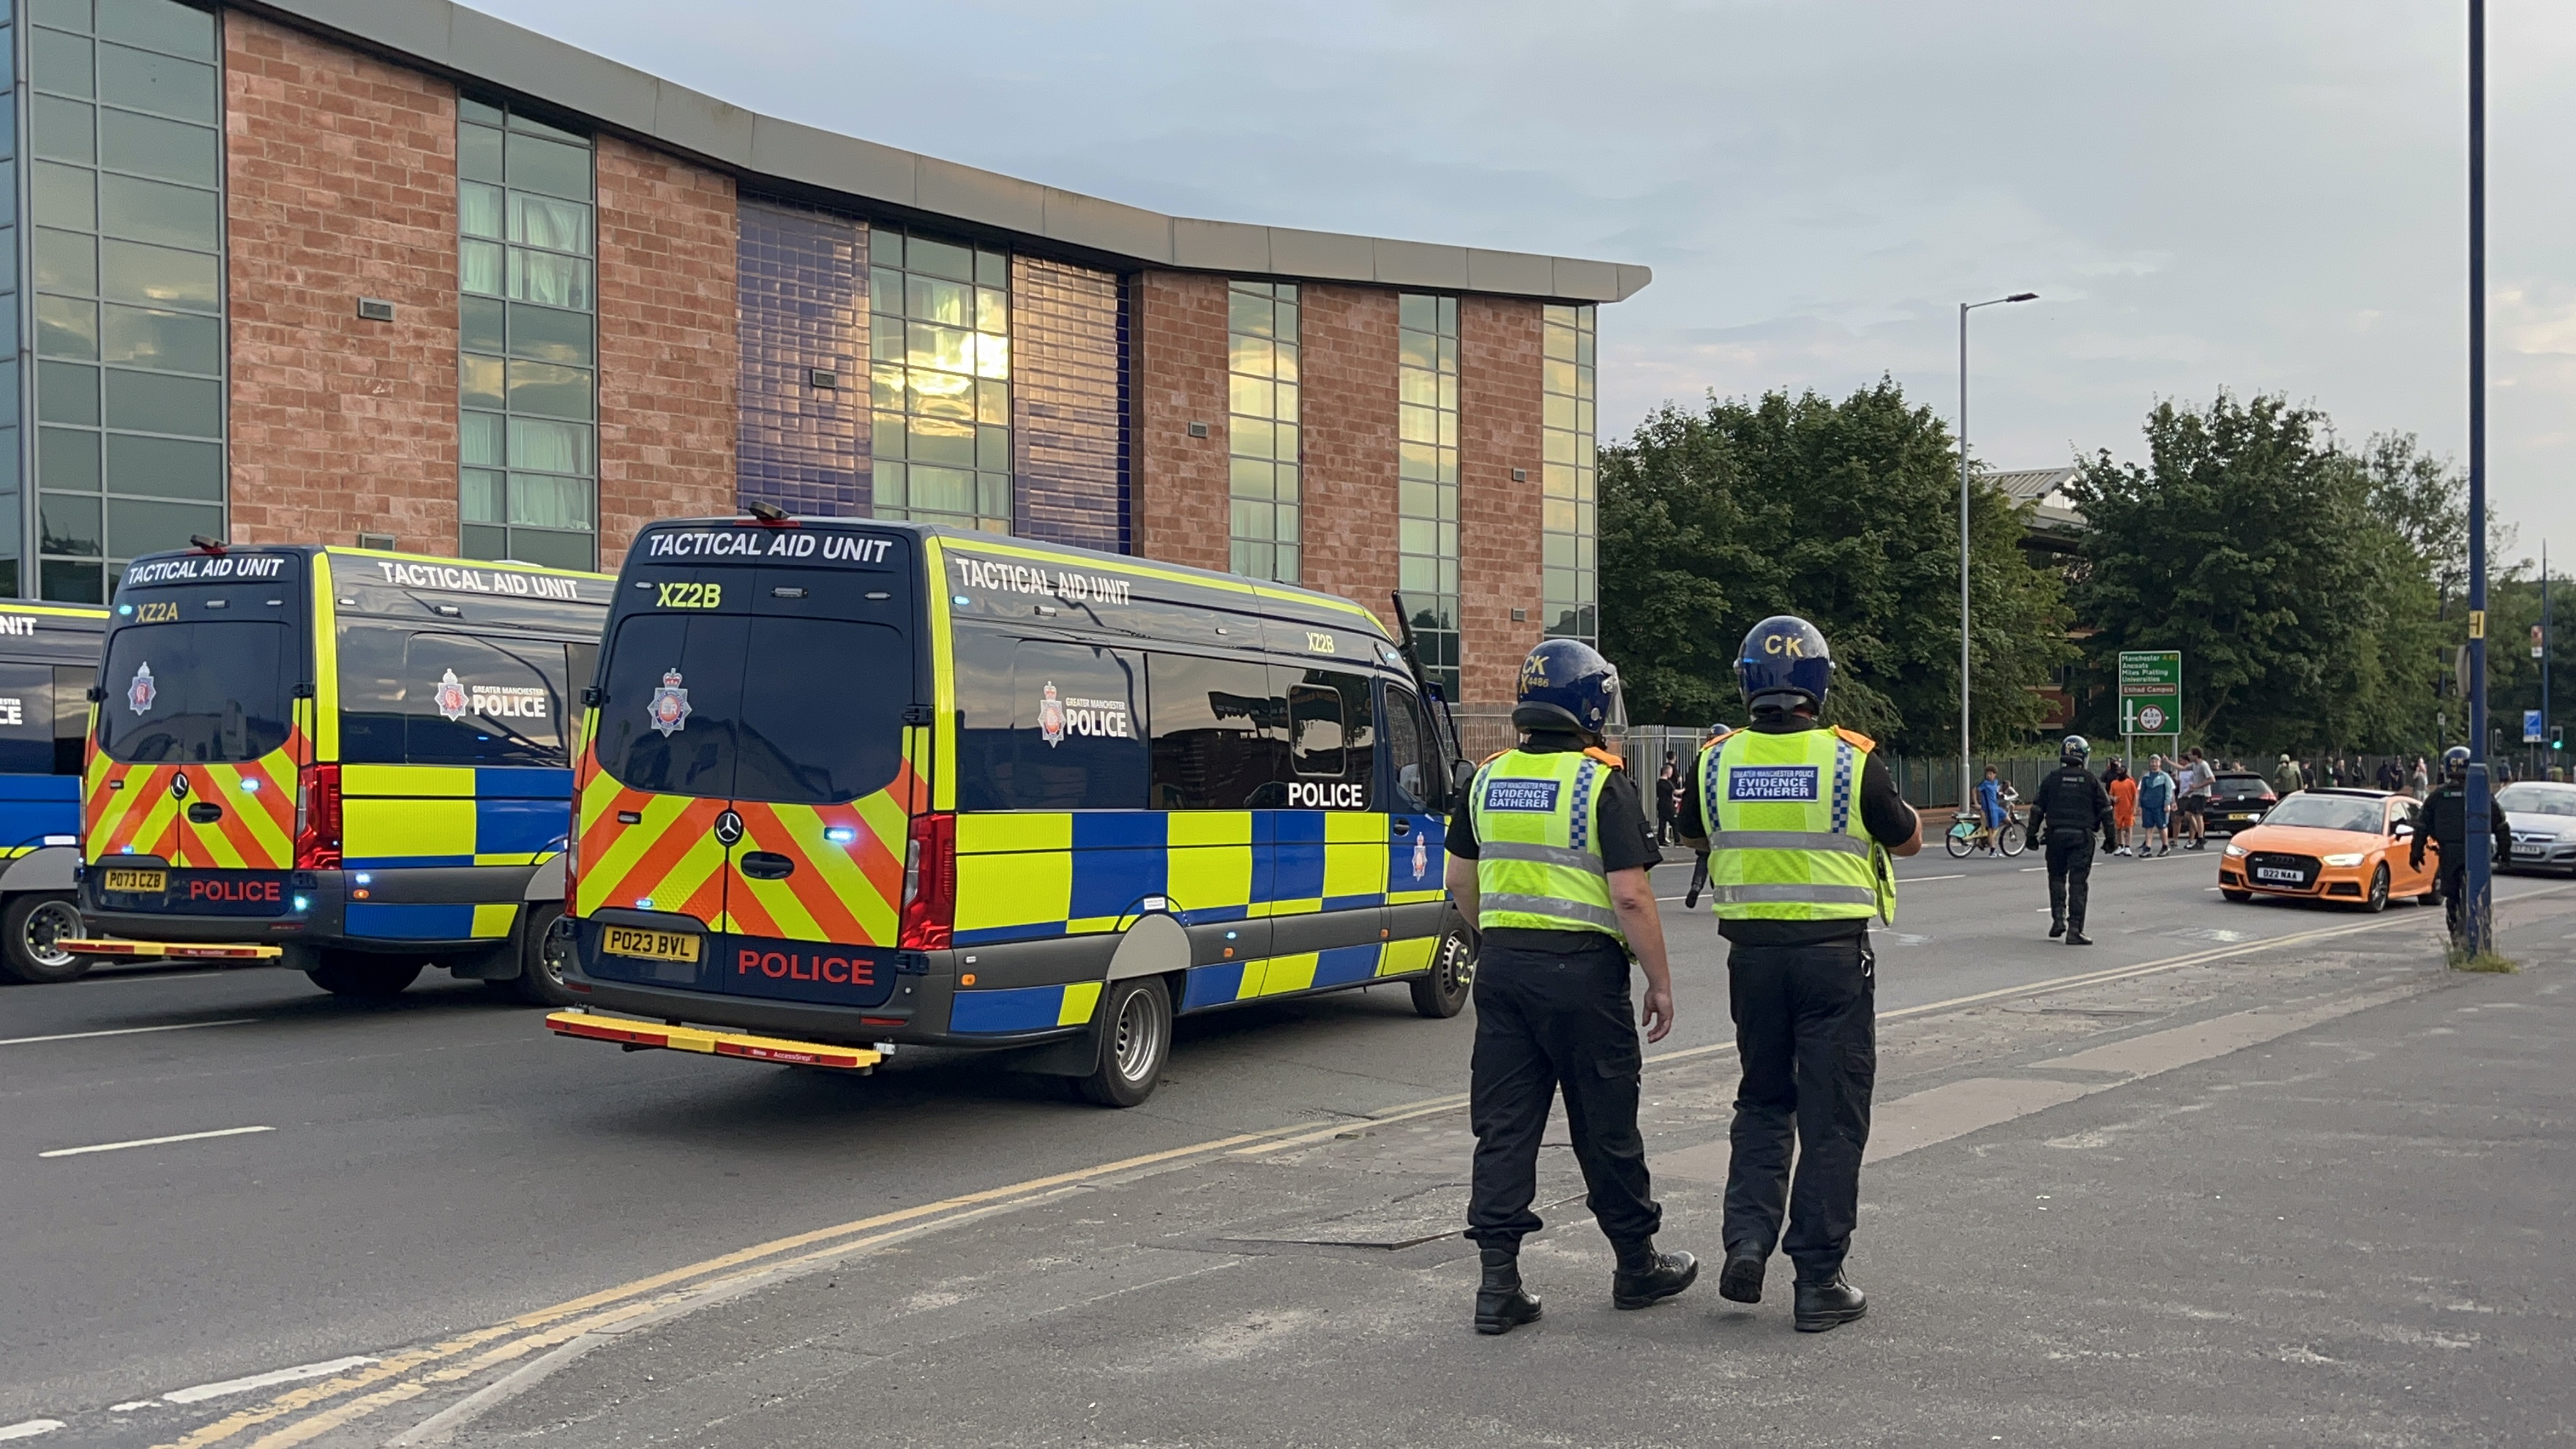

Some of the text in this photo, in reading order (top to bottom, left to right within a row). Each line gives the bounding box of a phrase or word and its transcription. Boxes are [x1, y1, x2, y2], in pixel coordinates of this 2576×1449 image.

[650, 533, 892, 563] TACTICAL AID UNIT
[129, 558, 284, 584] TACTICAL AID UNIT
[378, 562, 577, 599] TACTICAL AID UNIT
[956, 558, 1131, 605] TACTICAL AID UNIT
[656, 583, 722, 608] XZ2B
[135, 602, 179, 623] XZ2A
[1306, 632, 1335, 654] XZ2B
[1764, 634, 1804, 657] CK
[1522, 656, 1550, 675] CK
[472, 686, 544, 695] GREATER MANCHESTER
[473, 694, 546, 717] POLICE
[1066, 697, 1126, 710] GREATER MANCHESTER
[1066, 708, 1127, 737] POLICE
[1736, 787, 1809, 796] GATHERER
[1738, 778, 1808, 787] EVIDENCE
[1288, 782, 1363, 807] POLICE
[1489, 798, 1549, 808] GATHERER
[1491, 789, 1549, 799] EVIDENCE
[139, 874, 161, 888] CZB
[2264, 869, 2279, 877] D22
[190, 880, 281, 901] POLICE
[658, 936, 690, 957] BVL
[738, 949, 875, 986] POLICE
